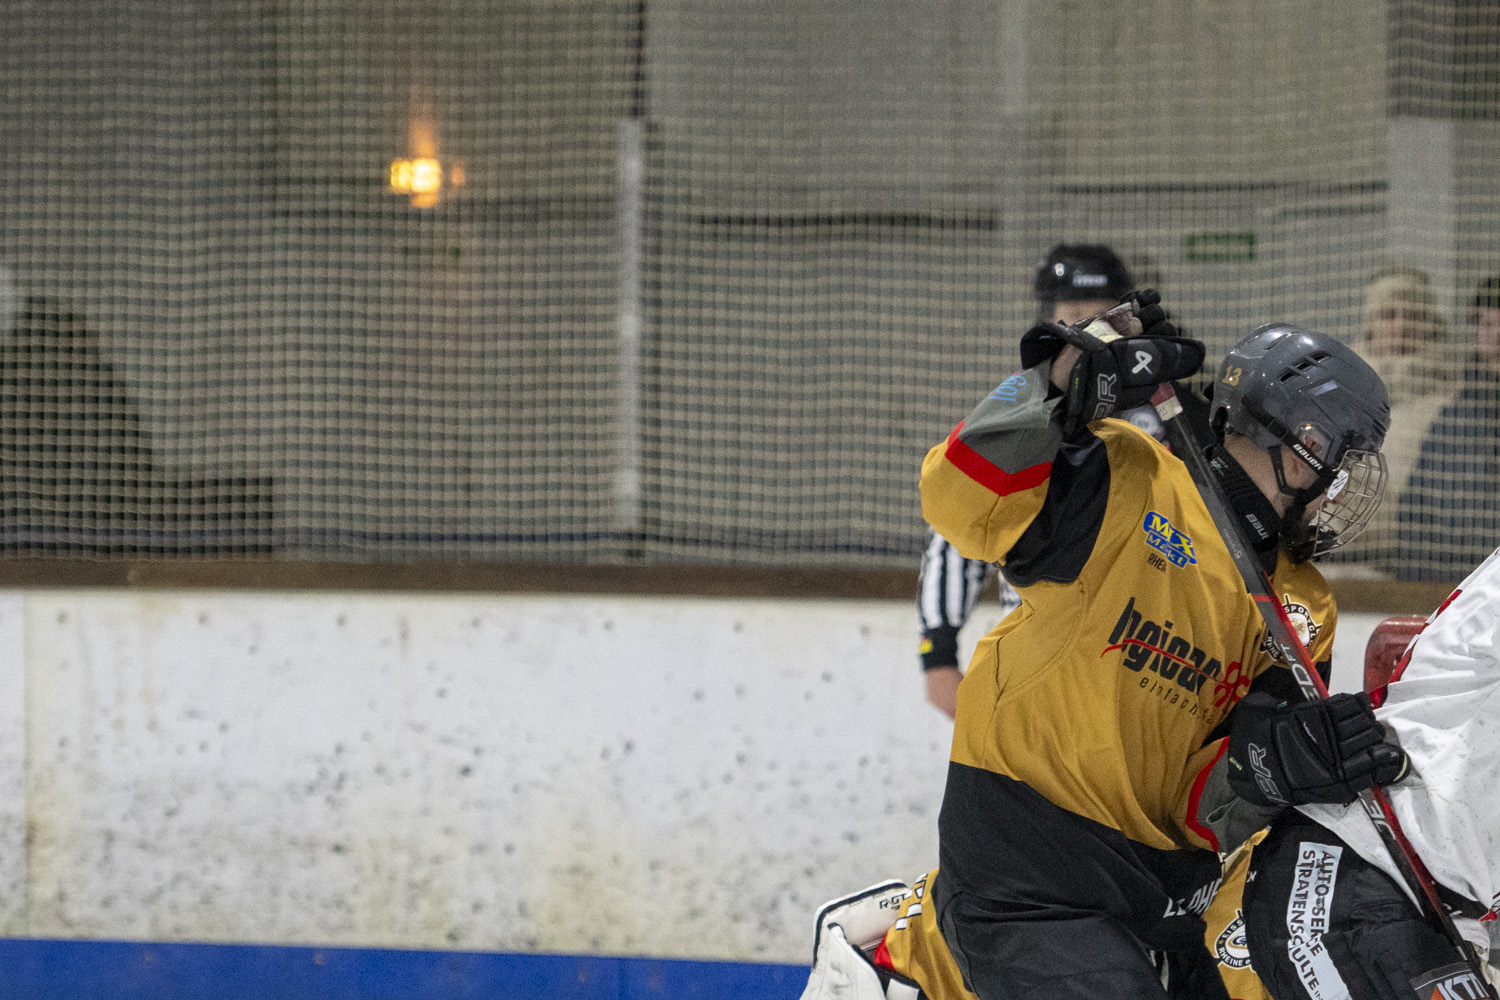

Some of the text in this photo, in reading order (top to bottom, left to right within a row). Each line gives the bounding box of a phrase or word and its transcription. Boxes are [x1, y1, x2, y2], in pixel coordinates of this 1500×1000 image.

[1222, 365, 1242, 387] 13
[1293, 443, 1323, 471] BAUER
[1149, 515, 1196, 559] MIX
[1218, 946, 1243, 967] RHEINE
